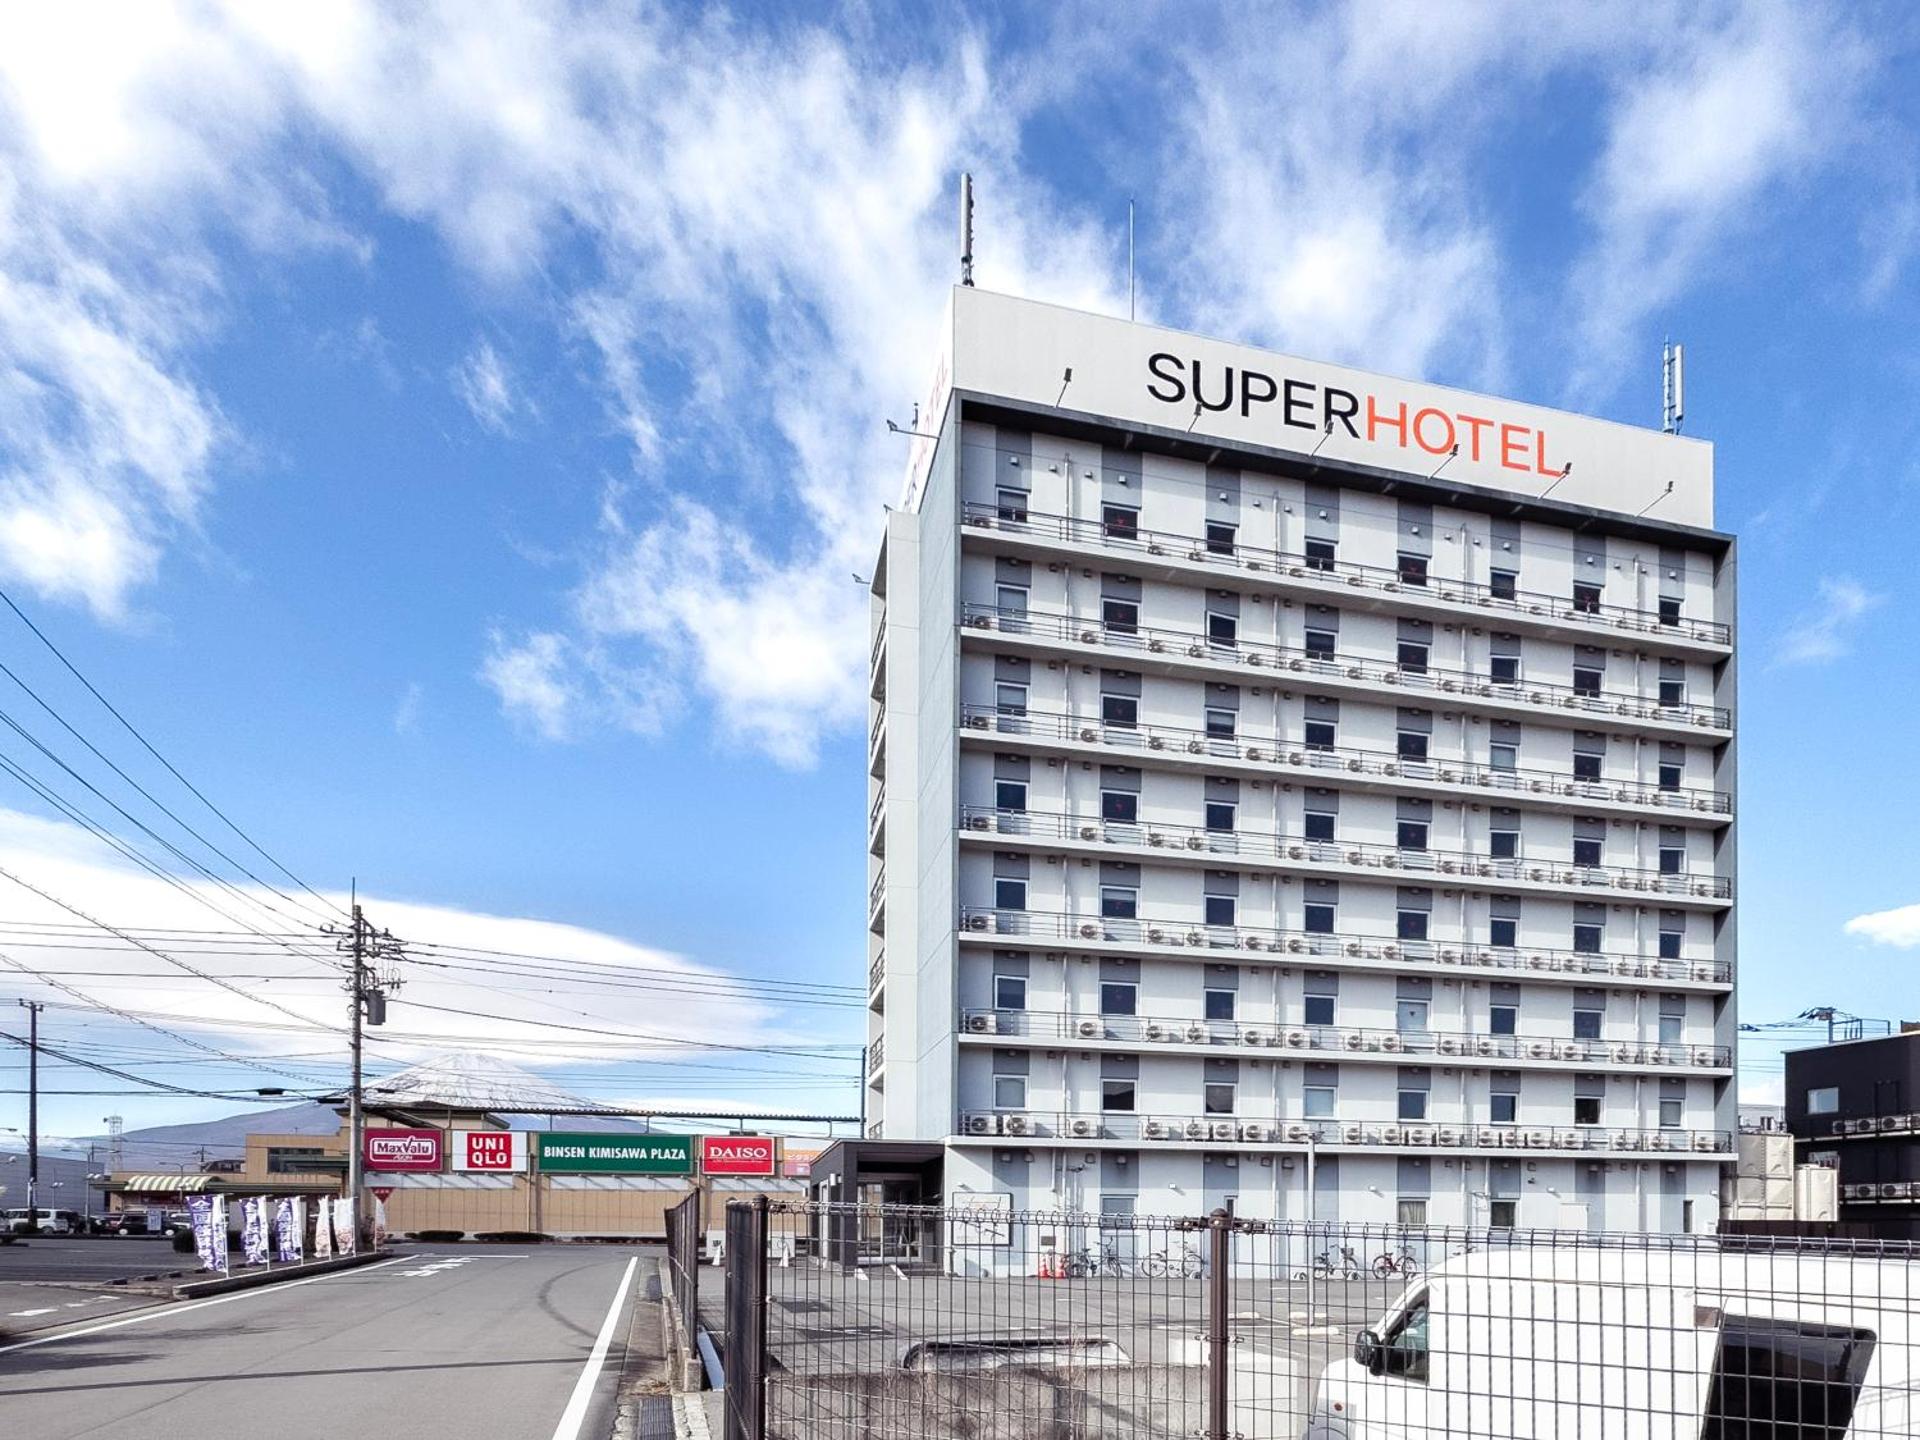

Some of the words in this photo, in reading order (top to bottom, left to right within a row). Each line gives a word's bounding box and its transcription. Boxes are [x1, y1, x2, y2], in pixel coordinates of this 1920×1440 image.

[377, 1136, 430, 1153] MaxValu
[472, 1137, 504, 1150] UNI
[472, 1152, 507, 1166] QLO
[544, 1146, 585, 1158] BINSEN
[589, 1147, 647, 1159] KIMISAWA
[651, 1148, 686, 1160] PLAZA
[709, 1146, 768, 1158] DAISO
